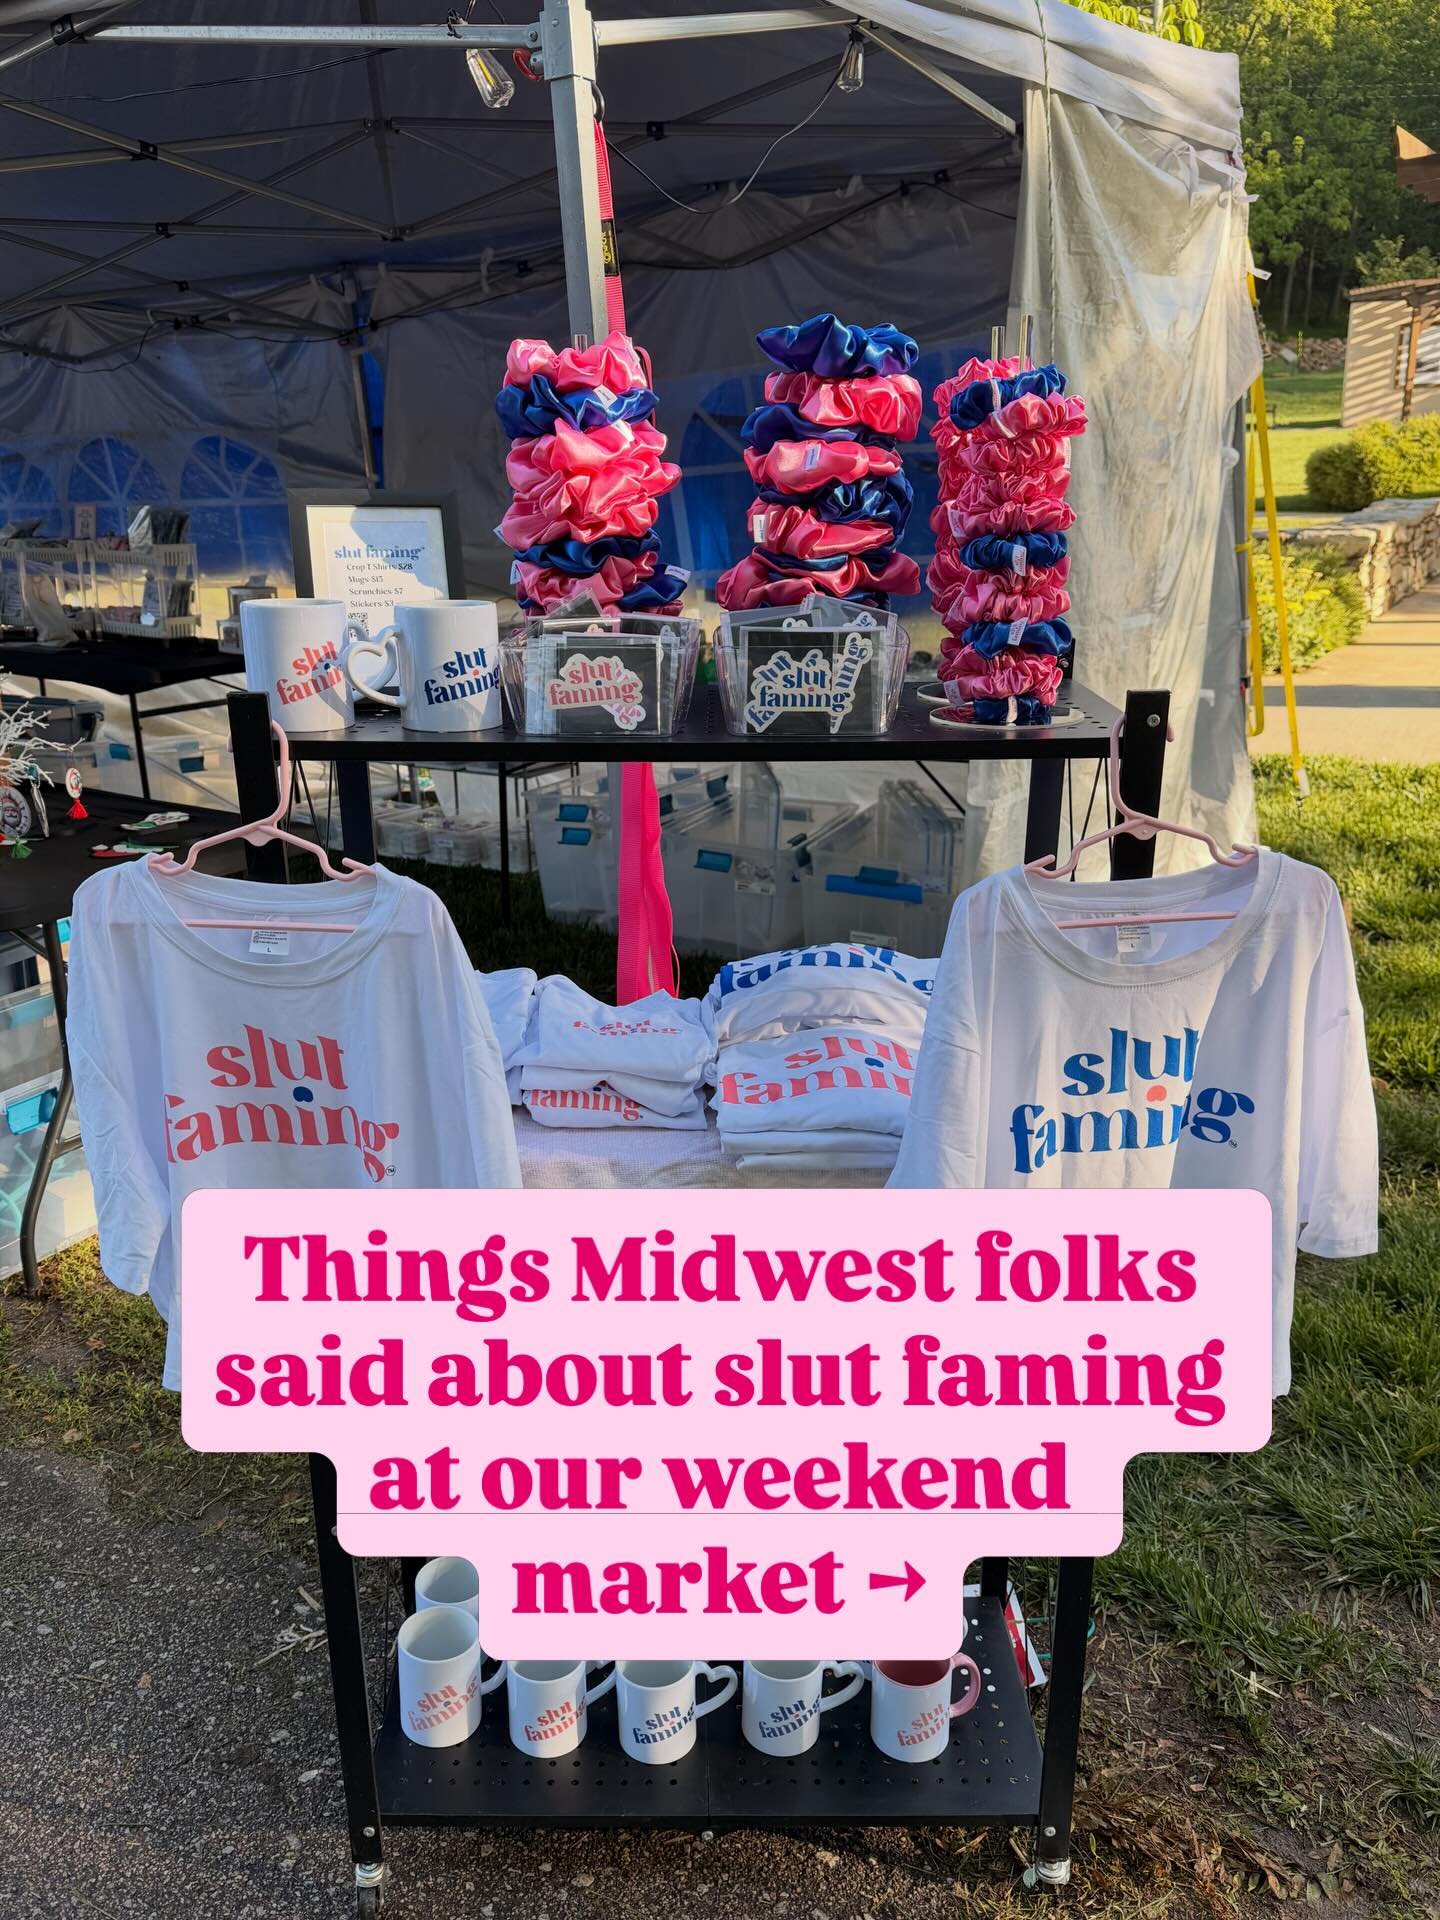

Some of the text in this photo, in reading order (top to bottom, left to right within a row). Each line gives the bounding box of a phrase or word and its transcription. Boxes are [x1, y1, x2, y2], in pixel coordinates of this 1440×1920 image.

[335, 544, 422, 561] slut faming
[346, 563, 366, 573] Crop
[398, 562, 414, 571] $28
[348, 576, 370, 585] Mugs
[349, 587, 404, 596] Scrunchies $7
[350, 600, 394, 608] Stickers $3
[292, 640, 338, 676] slut
[442, 647, 488, 678] slut
[568, 661, 612, 684] slut
[782, 666, 826, 689] slut
[550, 680, 639, 706] faming
[759, 685, 851, 712] faming
[206, 1023, 349, 1090] slut
[784, 1036, 914, 1071] slut
[1062, 1026, 1200, 1097] slut
[1010, 1085, 1256, 1174] faming
[416, 1685, 458, 1713] slut
[770, 1700, 807, 1723] slut
[536, 1701, 573, 1727] slut
[645, 1706, 682, 1730] slut
[911, 1703, 944, 1730] slut
